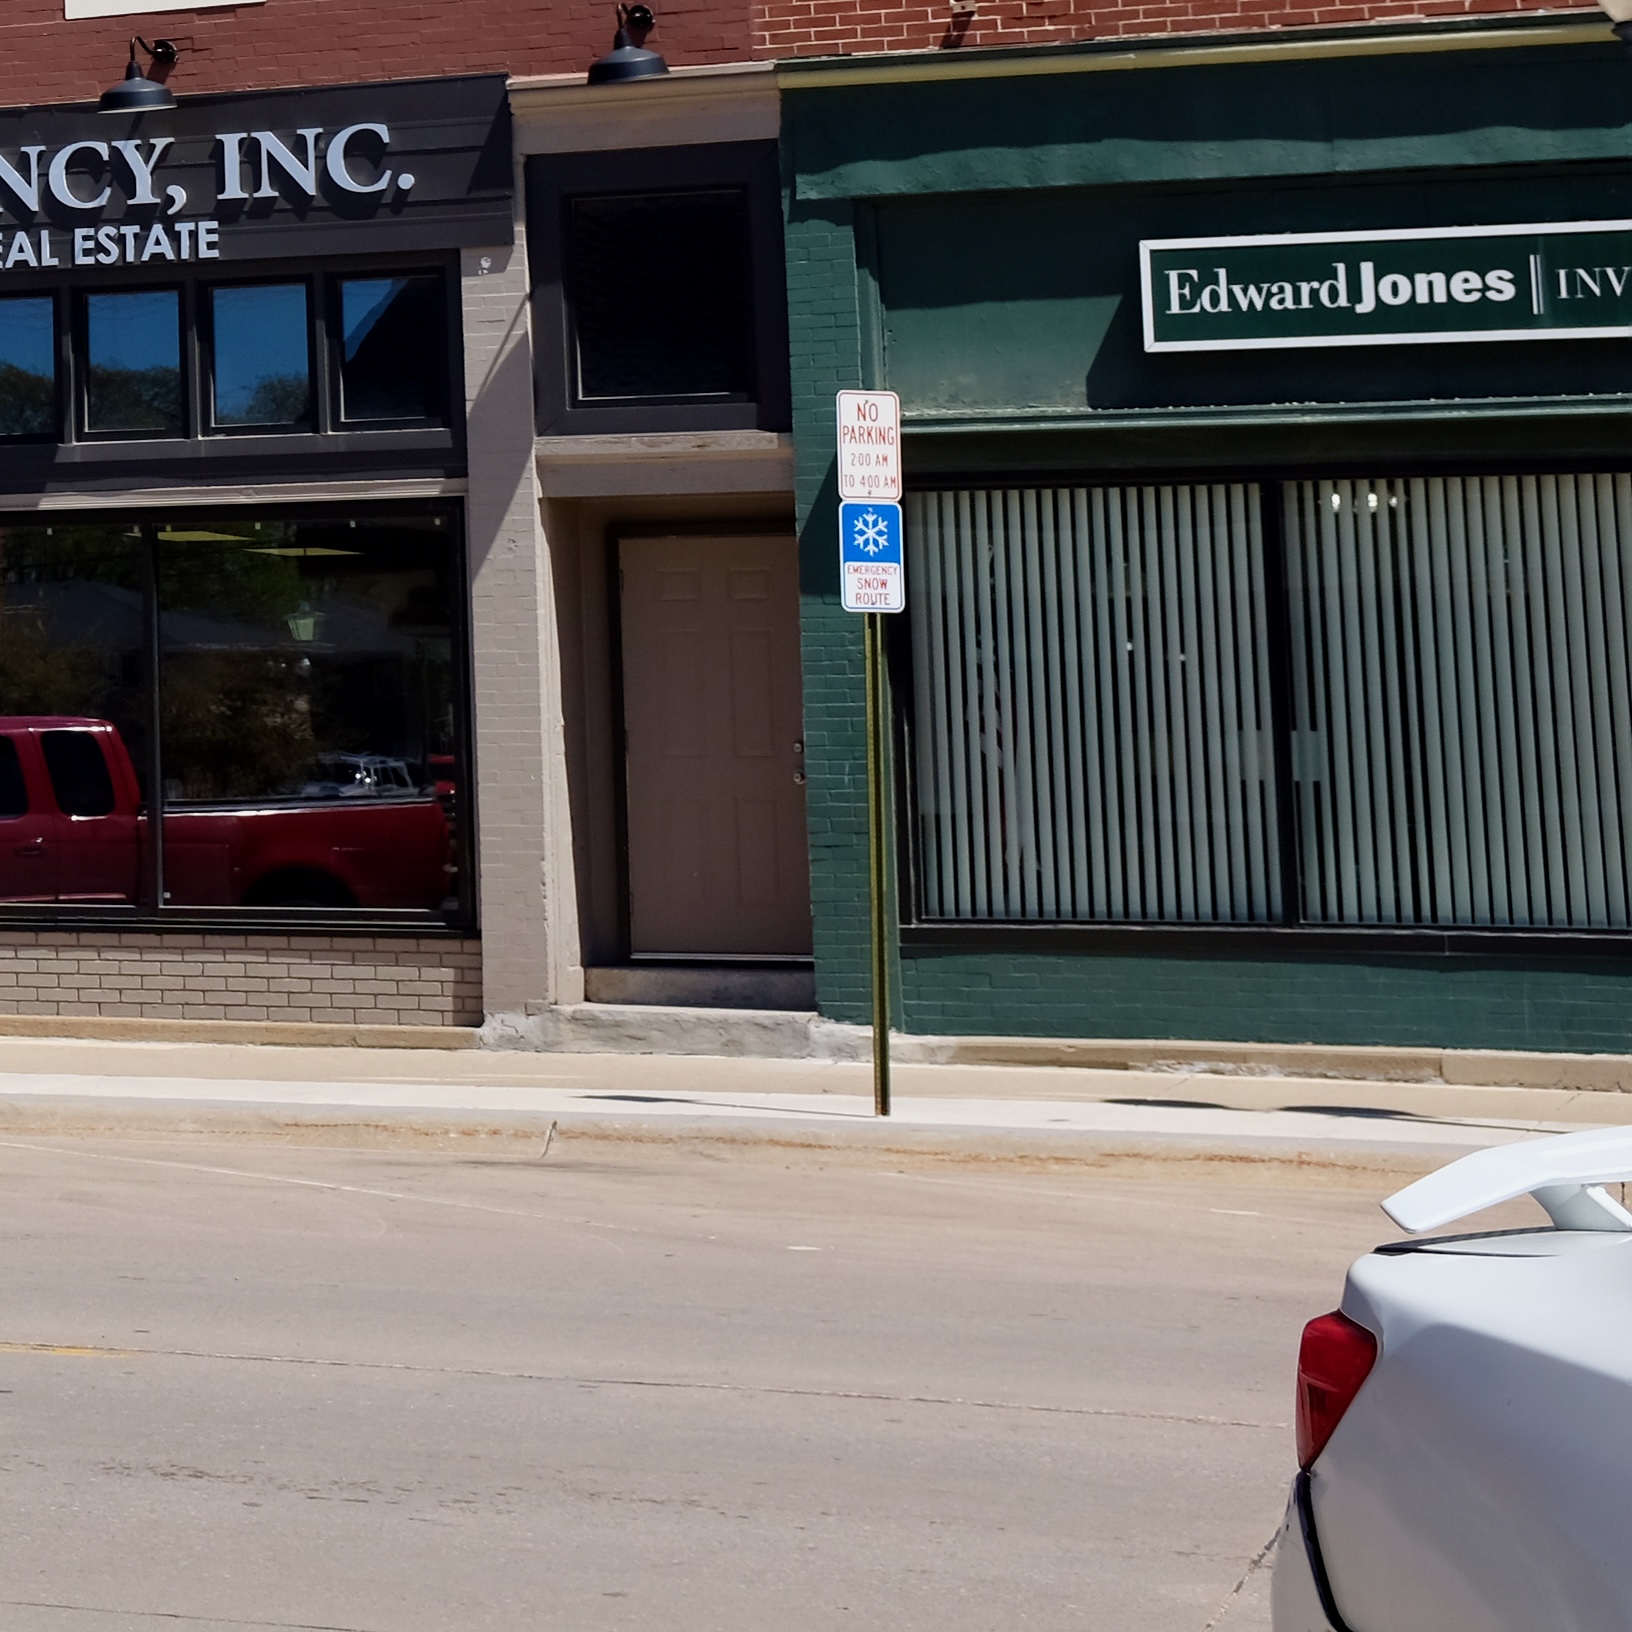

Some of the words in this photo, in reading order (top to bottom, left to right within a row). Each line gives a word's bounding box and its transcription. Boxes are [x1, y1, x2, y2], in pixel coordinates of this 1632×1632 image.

[216, 122, 415, 200] INC.
[74, 220, 220, 266] ESTATE
[857, 402, 879, 422] NO
[842, 425, 895, 446] PARKING
[875, 454, 888, 467] AM
[844, 474, 855, 488] TO
[883, 475, 897, 489] AM
[847, 564, 897, 575] EMERGENCY
[857, 577, 888, 590] SNOW
[855, 592, 891, 606] ROUTE
